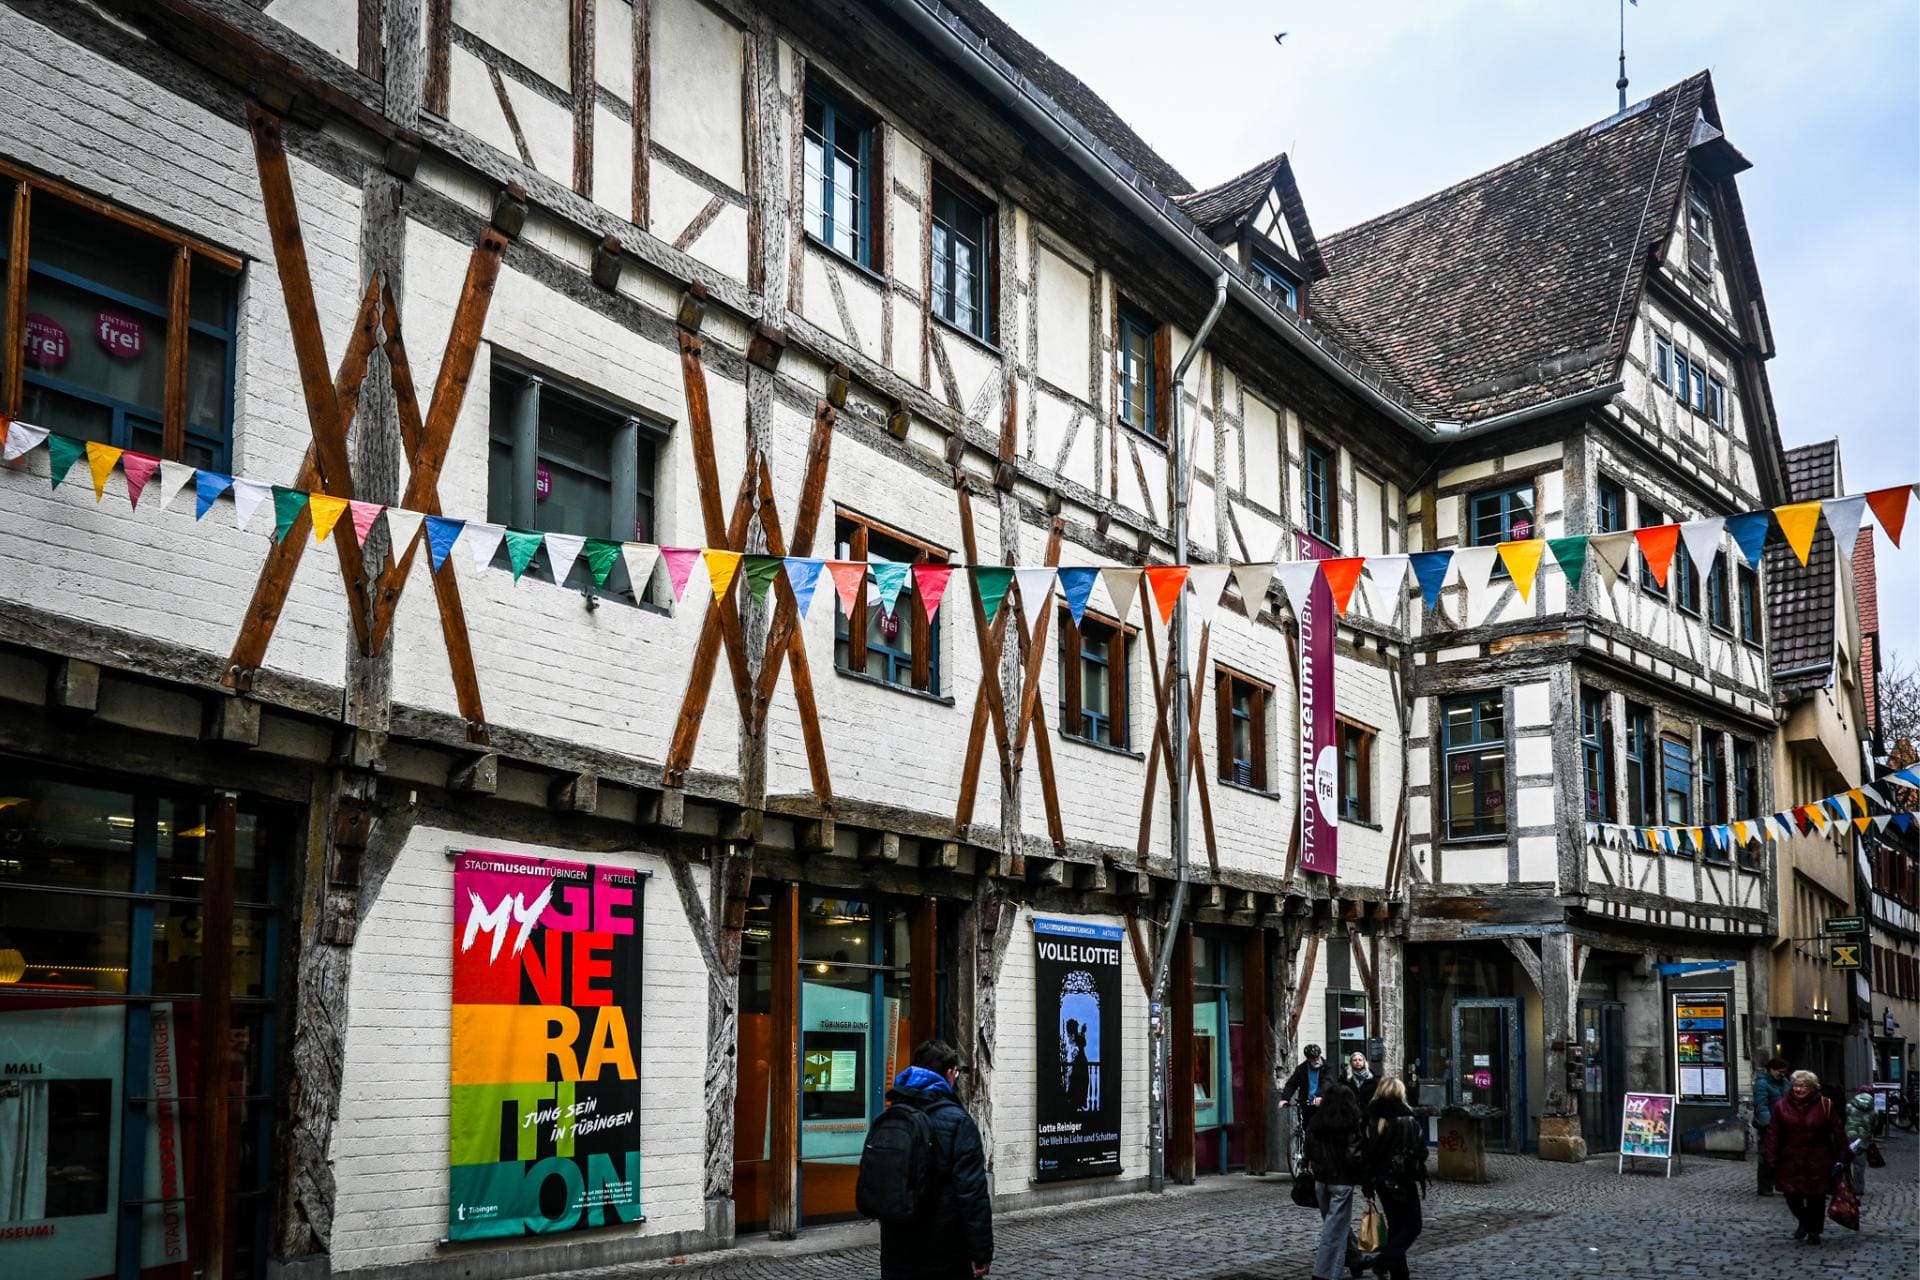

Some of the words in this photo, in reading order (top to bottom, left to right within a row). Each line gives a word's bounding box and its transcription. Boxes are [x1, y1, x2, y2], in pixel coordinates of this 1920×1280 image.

[26, 320, 64, 337] INTRITT
[100, 313, 139, 331] EINTRITT
[24, 327, 64, 357] frei
[101, 321, 140, 350] frei
[537, 478, 549, 493] ei
[881, 615, 898, 633] frei
[1319, 777, 1333, 800] frei
[464, 859, 588, 880] STADTmuseumTÜBINGEN
[602, 873, 637, 884] AKTUELL
[461, 879, 555, 966] MY
[1038, 942, 1078, 962] VOLLE
[1080, 946, 1119, 966] LOTTE!
[1833, 946, 1859, 966] X
[852, 1021, 869, 1030] DING
[528, 1004, 638, 1082] RA
[5, 1063, 42, 1075] MAL!
[1475, 1074, 1490, 1087] frei
[1627, 1098, 1649, 1112] MY
[522, 1107, 562, 1129] JUNG
[1038, 1123, 1056, 1133] Lotte
[1056, 1121, 1082, 1133] Reiniger
[1039, 1136, 1050, 1147] Die
[1050, 1135, 1063, 1146] Welt
[1064, 1135, 1069, 1144] in
[1070, 1133, 1083, 1143] Licht
[1084, 1132, 1095, 1143] und
[1096, 1132, 1118, 1142] Schatten
[468, 1205, 498, 1214] Tübingen
